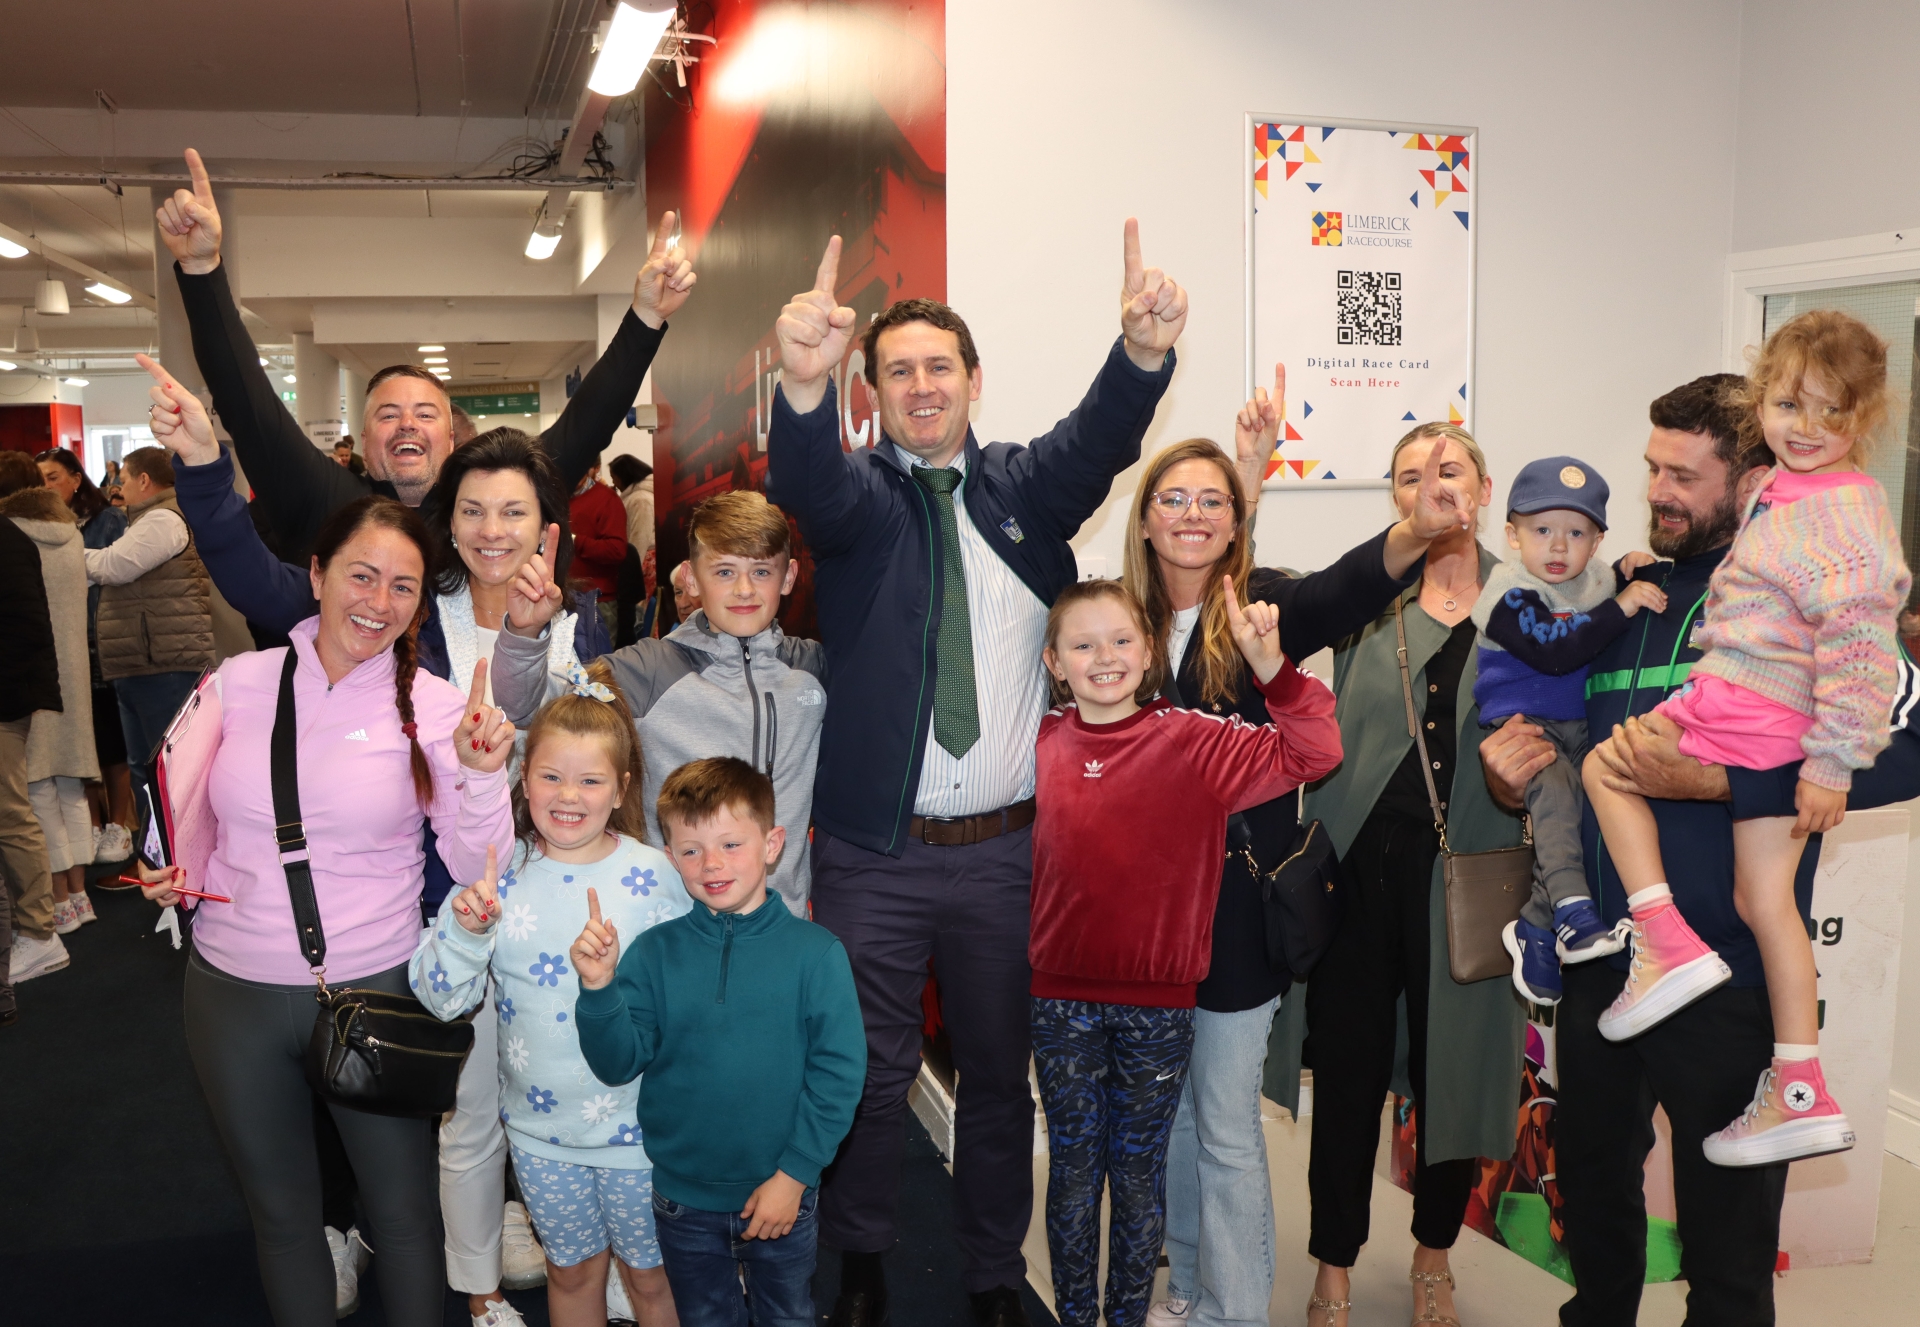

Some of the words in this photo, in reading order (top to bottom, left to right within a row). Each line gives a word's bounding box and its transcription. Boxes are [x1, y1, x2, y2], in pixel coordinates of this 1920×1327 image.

[1347, 214, 1411, 231] LIMERICK
[1347, 235, 1413, 248] RACECOURSE
[1307, 357, 1356, 369] Digital
[1362, 358, 1393, 368] Race
[1399, 359, 1430, 369] Card
[1330, 377, 1361, 387] Scan
[1368, 378, 1400, 387] Here
[450, 386, 488, 395] OODLANDS
[490, 384, 527, 393] CATERING
[1787, 1083, 1809, 1095] CONVERSE
